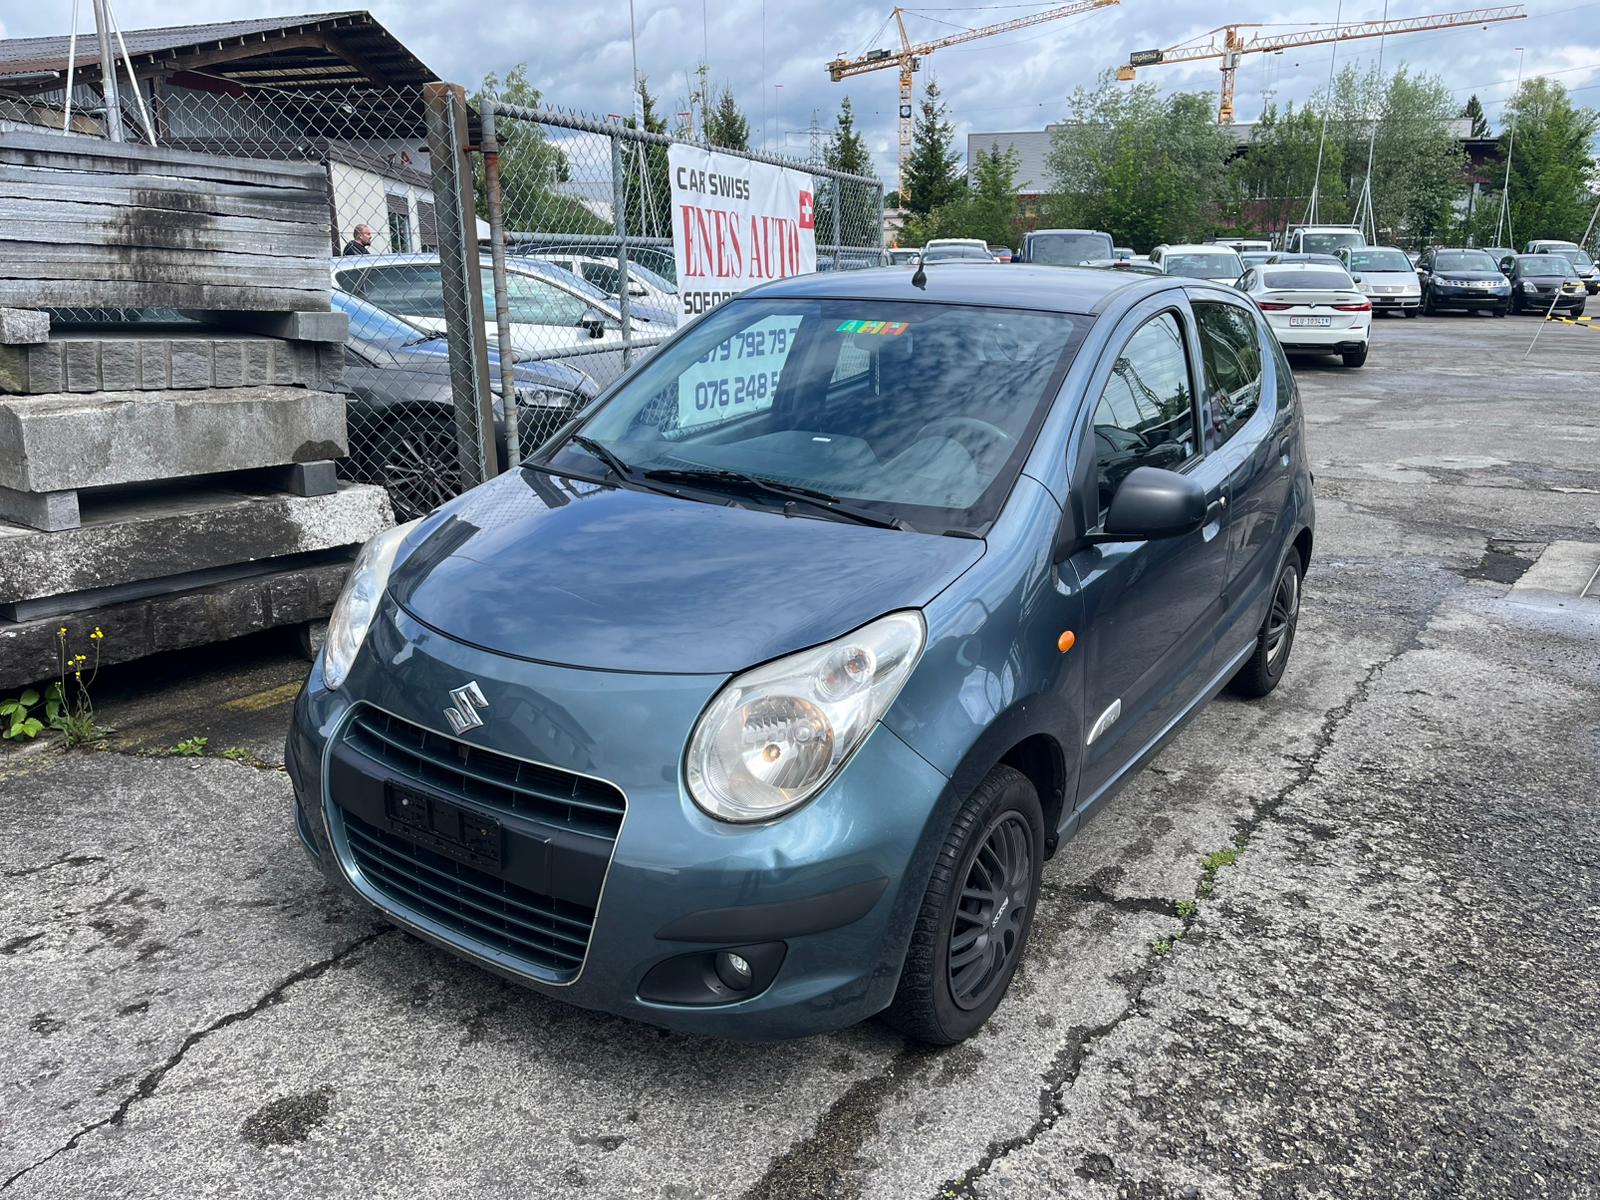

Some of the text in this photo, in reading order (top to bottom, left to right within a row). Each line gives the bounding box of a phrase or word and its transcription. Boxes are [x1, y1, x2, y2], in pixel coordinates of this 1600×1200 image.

[676, 166, 750, 200] CAR SWISS
[680, 204, 800, 279] ENES AUTO
[736, 331, 765, 359] 792
[695, 379, 730, 410] 076
[734, 372, 767, 404] 248
